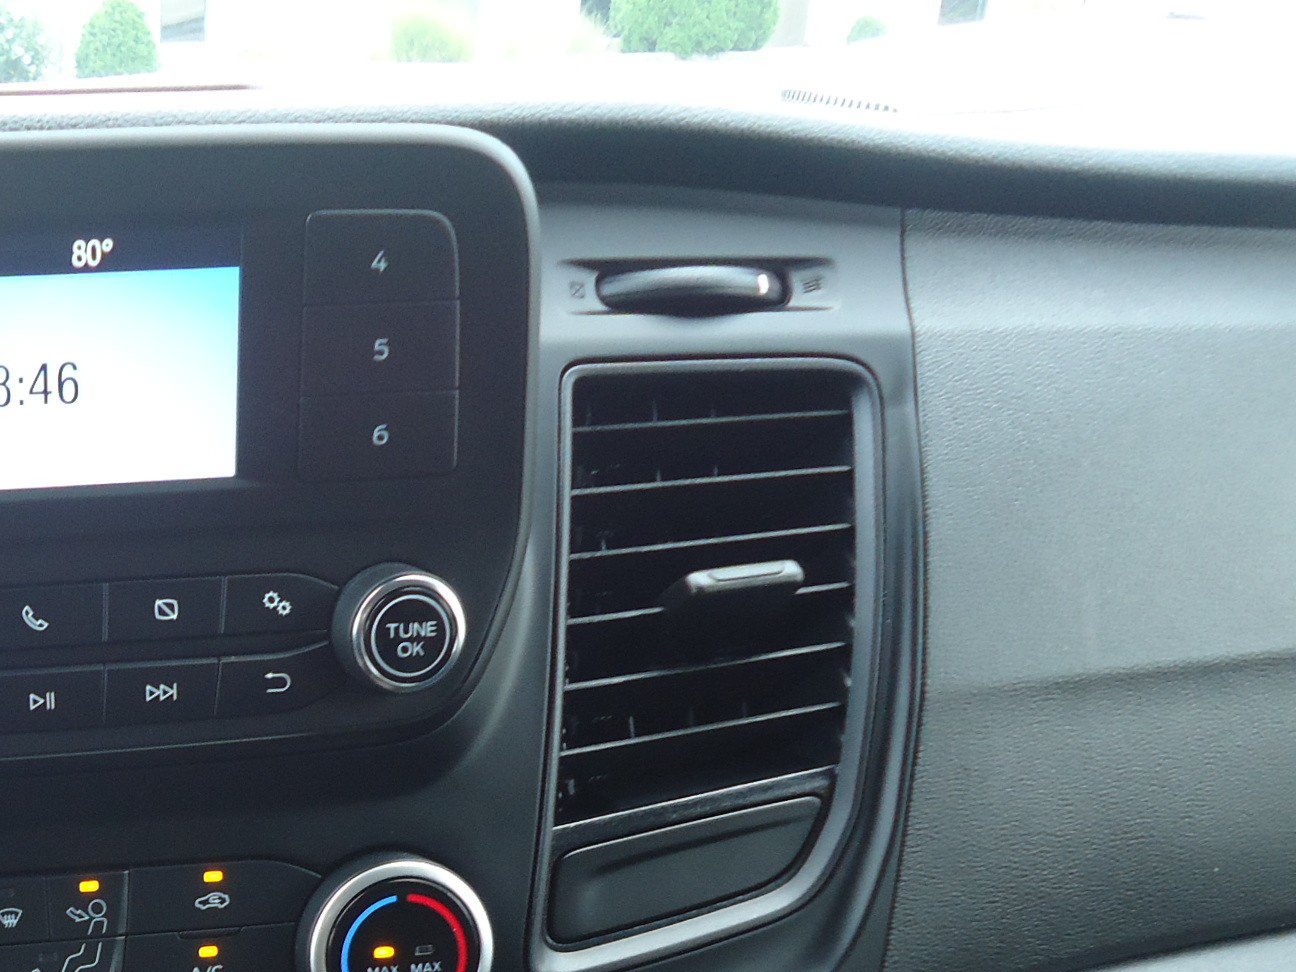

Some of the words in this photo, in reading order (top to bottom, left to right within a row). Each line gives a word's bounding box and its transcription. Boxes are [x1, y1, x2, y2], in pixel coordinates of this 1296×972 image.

[370, 250, 388, 272] 4
[373, 338, 390, 360] 5
[372, 423, 389, 446] 6
[385, 620, 438, 640] TUNE
[396, 639, 425, 658] OK
